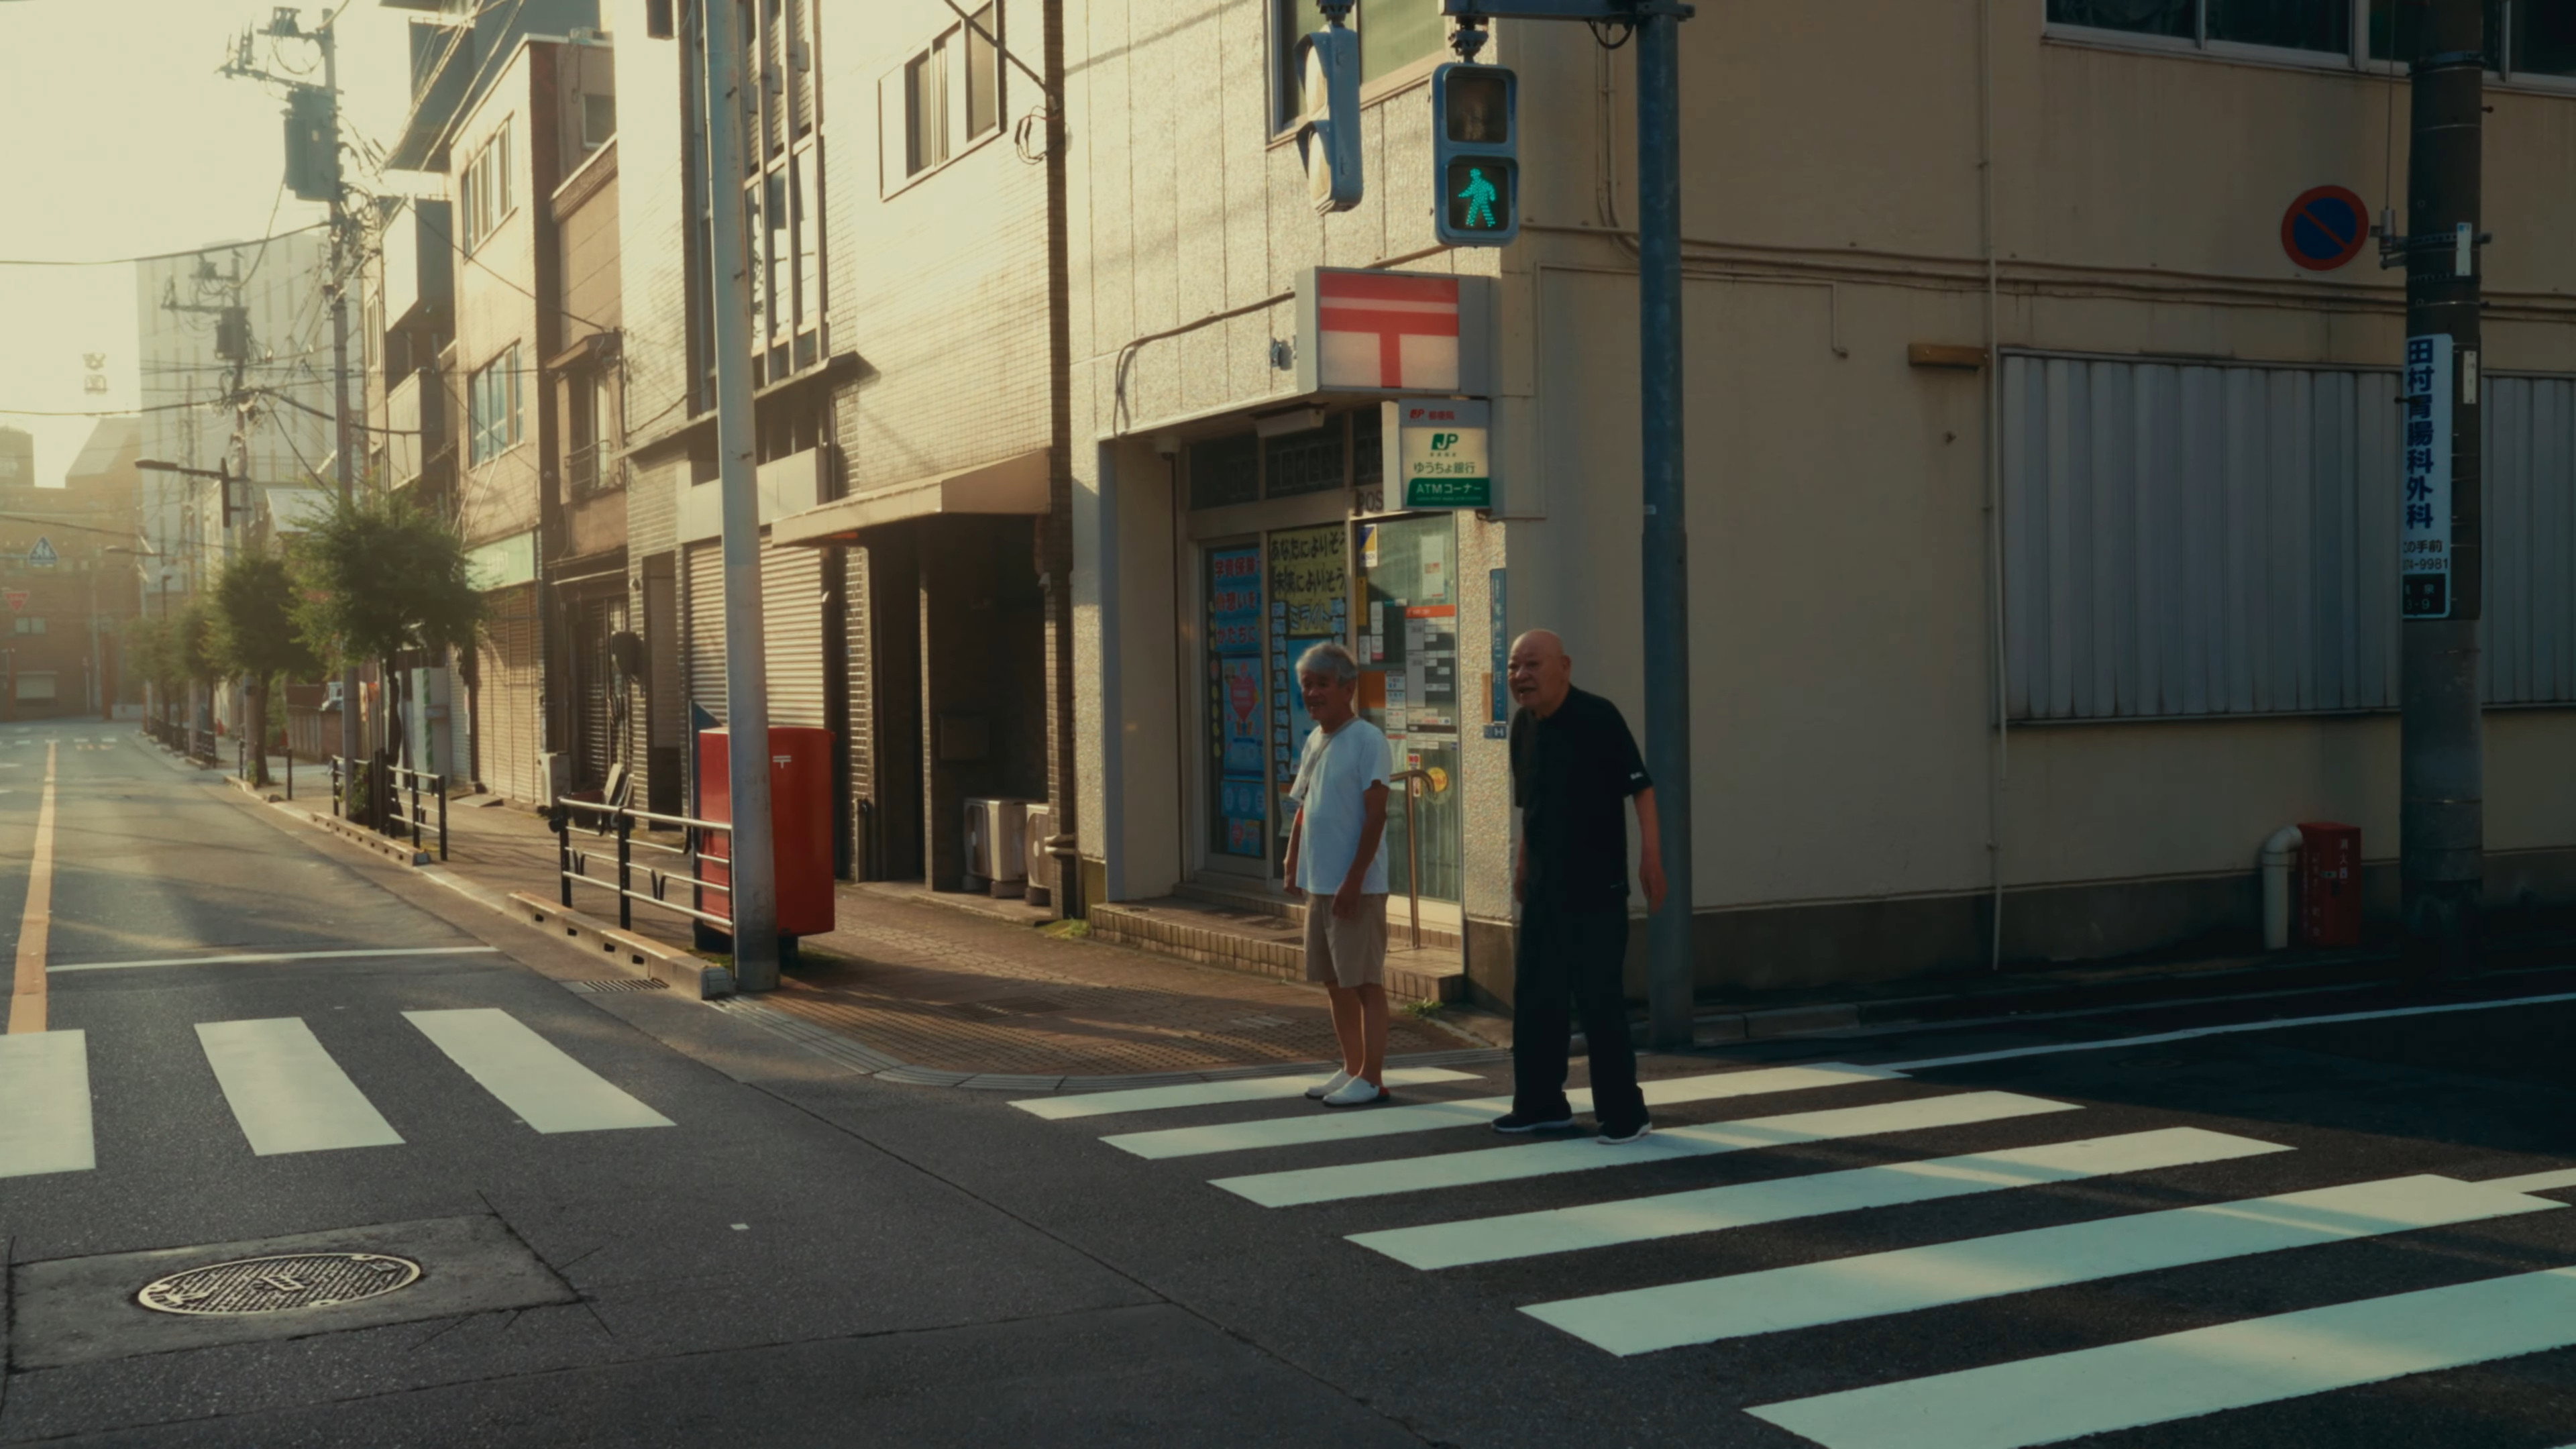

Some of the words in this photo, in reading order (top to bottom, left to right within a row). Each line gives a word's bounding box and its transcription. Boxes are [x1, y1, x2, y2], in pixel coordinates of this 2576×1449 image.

[1431, 433, 1458, 451] JP
[1413, 462, 1475, 474] ゆうちょ銀行
[1416, 483, 1482, 494] ATMコーナー
